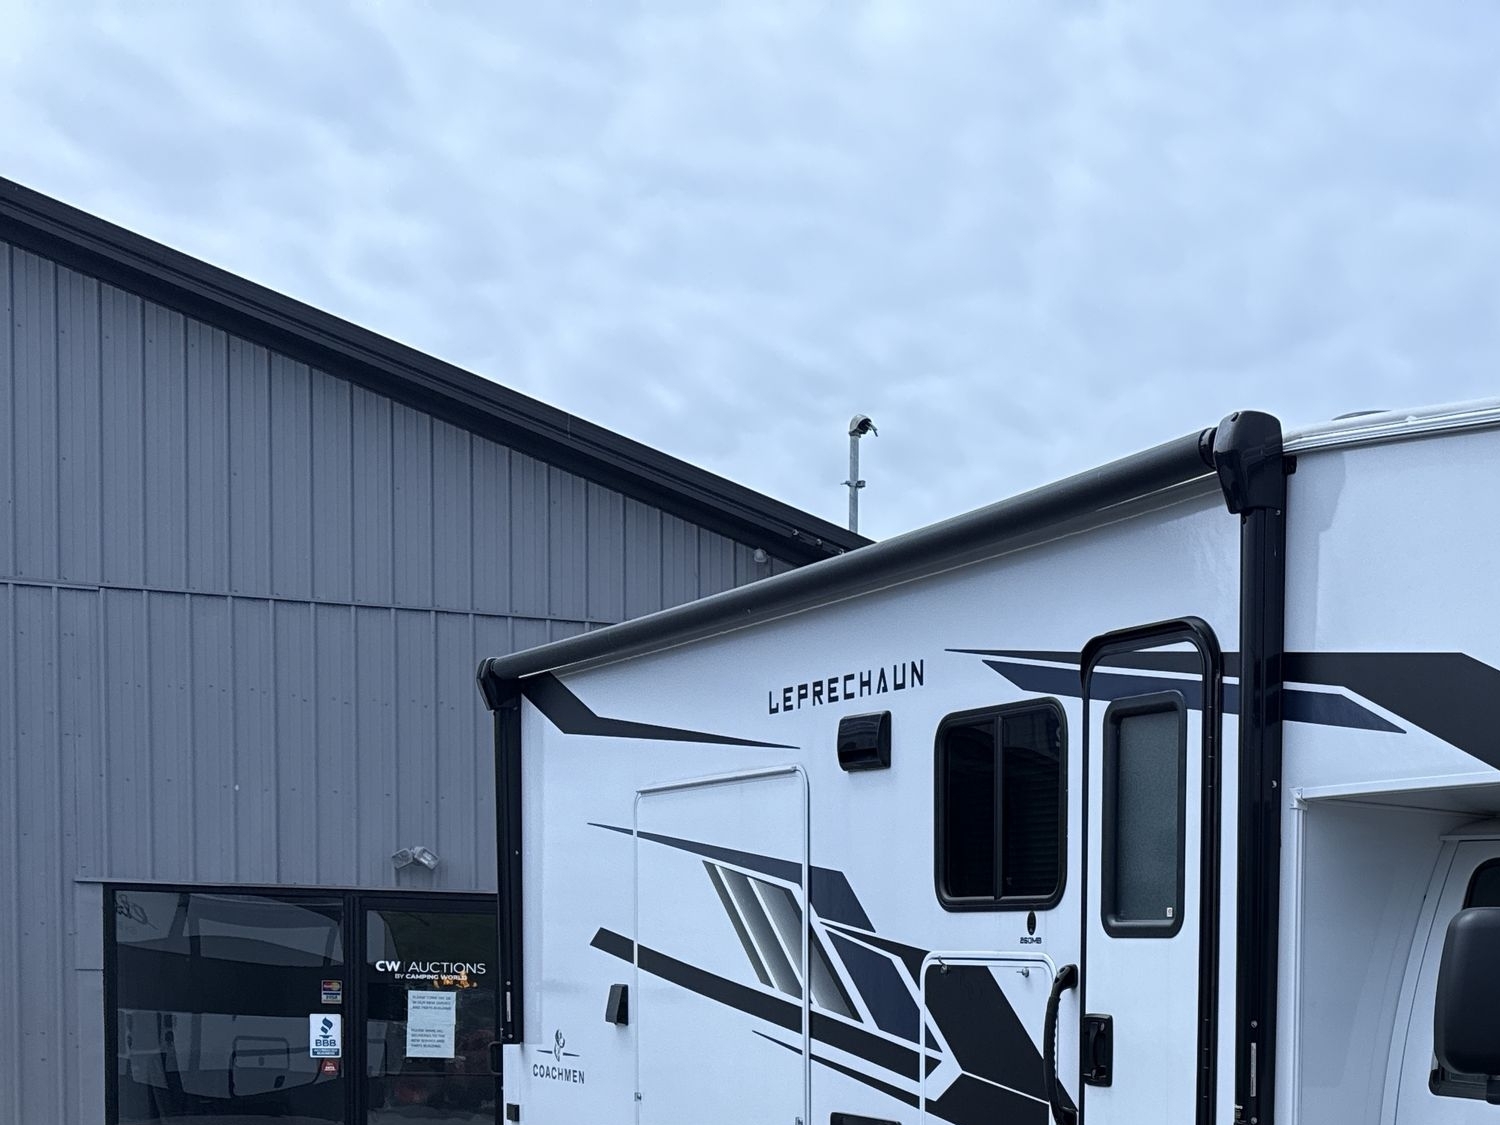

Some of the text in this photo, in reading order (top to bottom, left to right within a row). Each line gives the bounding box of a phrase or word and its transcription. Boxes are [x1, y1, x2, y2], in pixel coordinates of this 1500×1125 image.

[768, 658, 925, 716] LEPRECHAUN
[375, 960, 487, 975] CW AUCTIONS
[314, 1039, 337, 1047] BBB
[532, 1063, 586, 1085] COACHMEN
